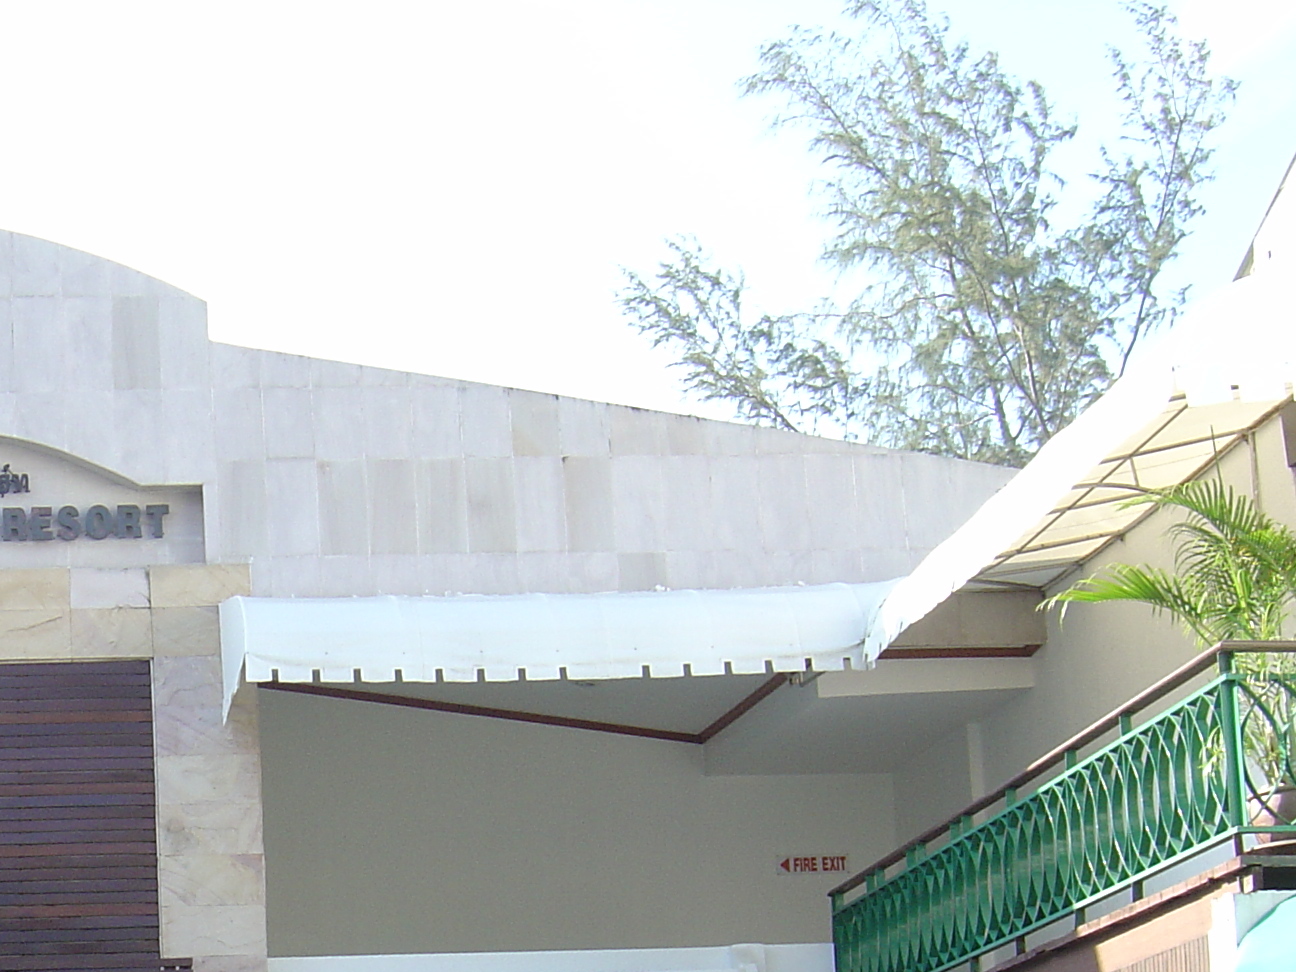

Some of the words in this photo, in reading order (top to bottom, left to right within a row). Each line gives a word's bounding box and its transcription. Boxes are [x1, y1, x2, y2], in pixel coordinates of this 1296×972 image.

[2, 503, 171, 544] RESORT
[793, 856, 818, 872] FIRE
[822, 855, 847, 871] EXIT
